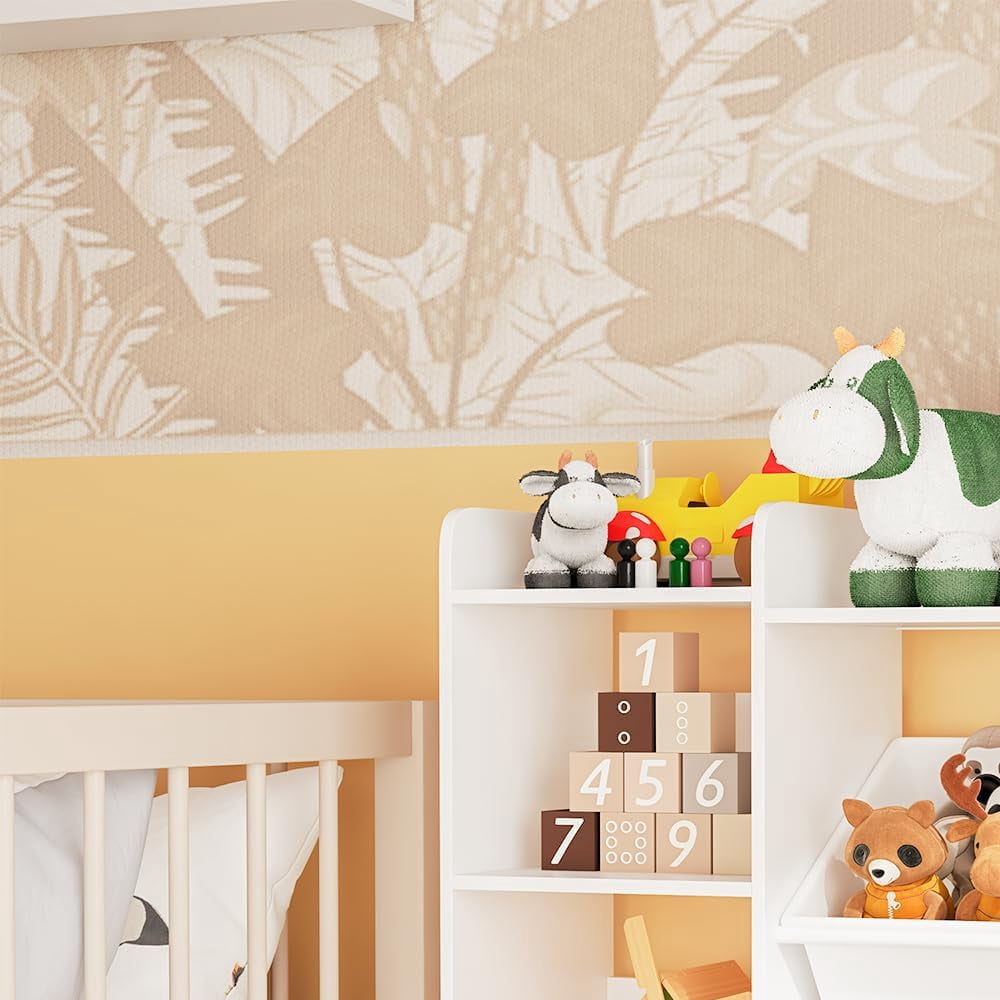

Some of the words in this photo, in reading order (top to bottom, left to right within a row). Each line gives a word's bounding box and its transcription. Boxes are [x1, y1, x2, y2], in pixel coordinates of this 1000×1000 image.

[635, 638, 657, 687] 1
[579, 758, 613, 806] 4
[634, 759, 667, 807] 5
[695, 759, 725, 808] 6
[550, 817, 585, 865] 7
[668, 819, 698, 868] 9
